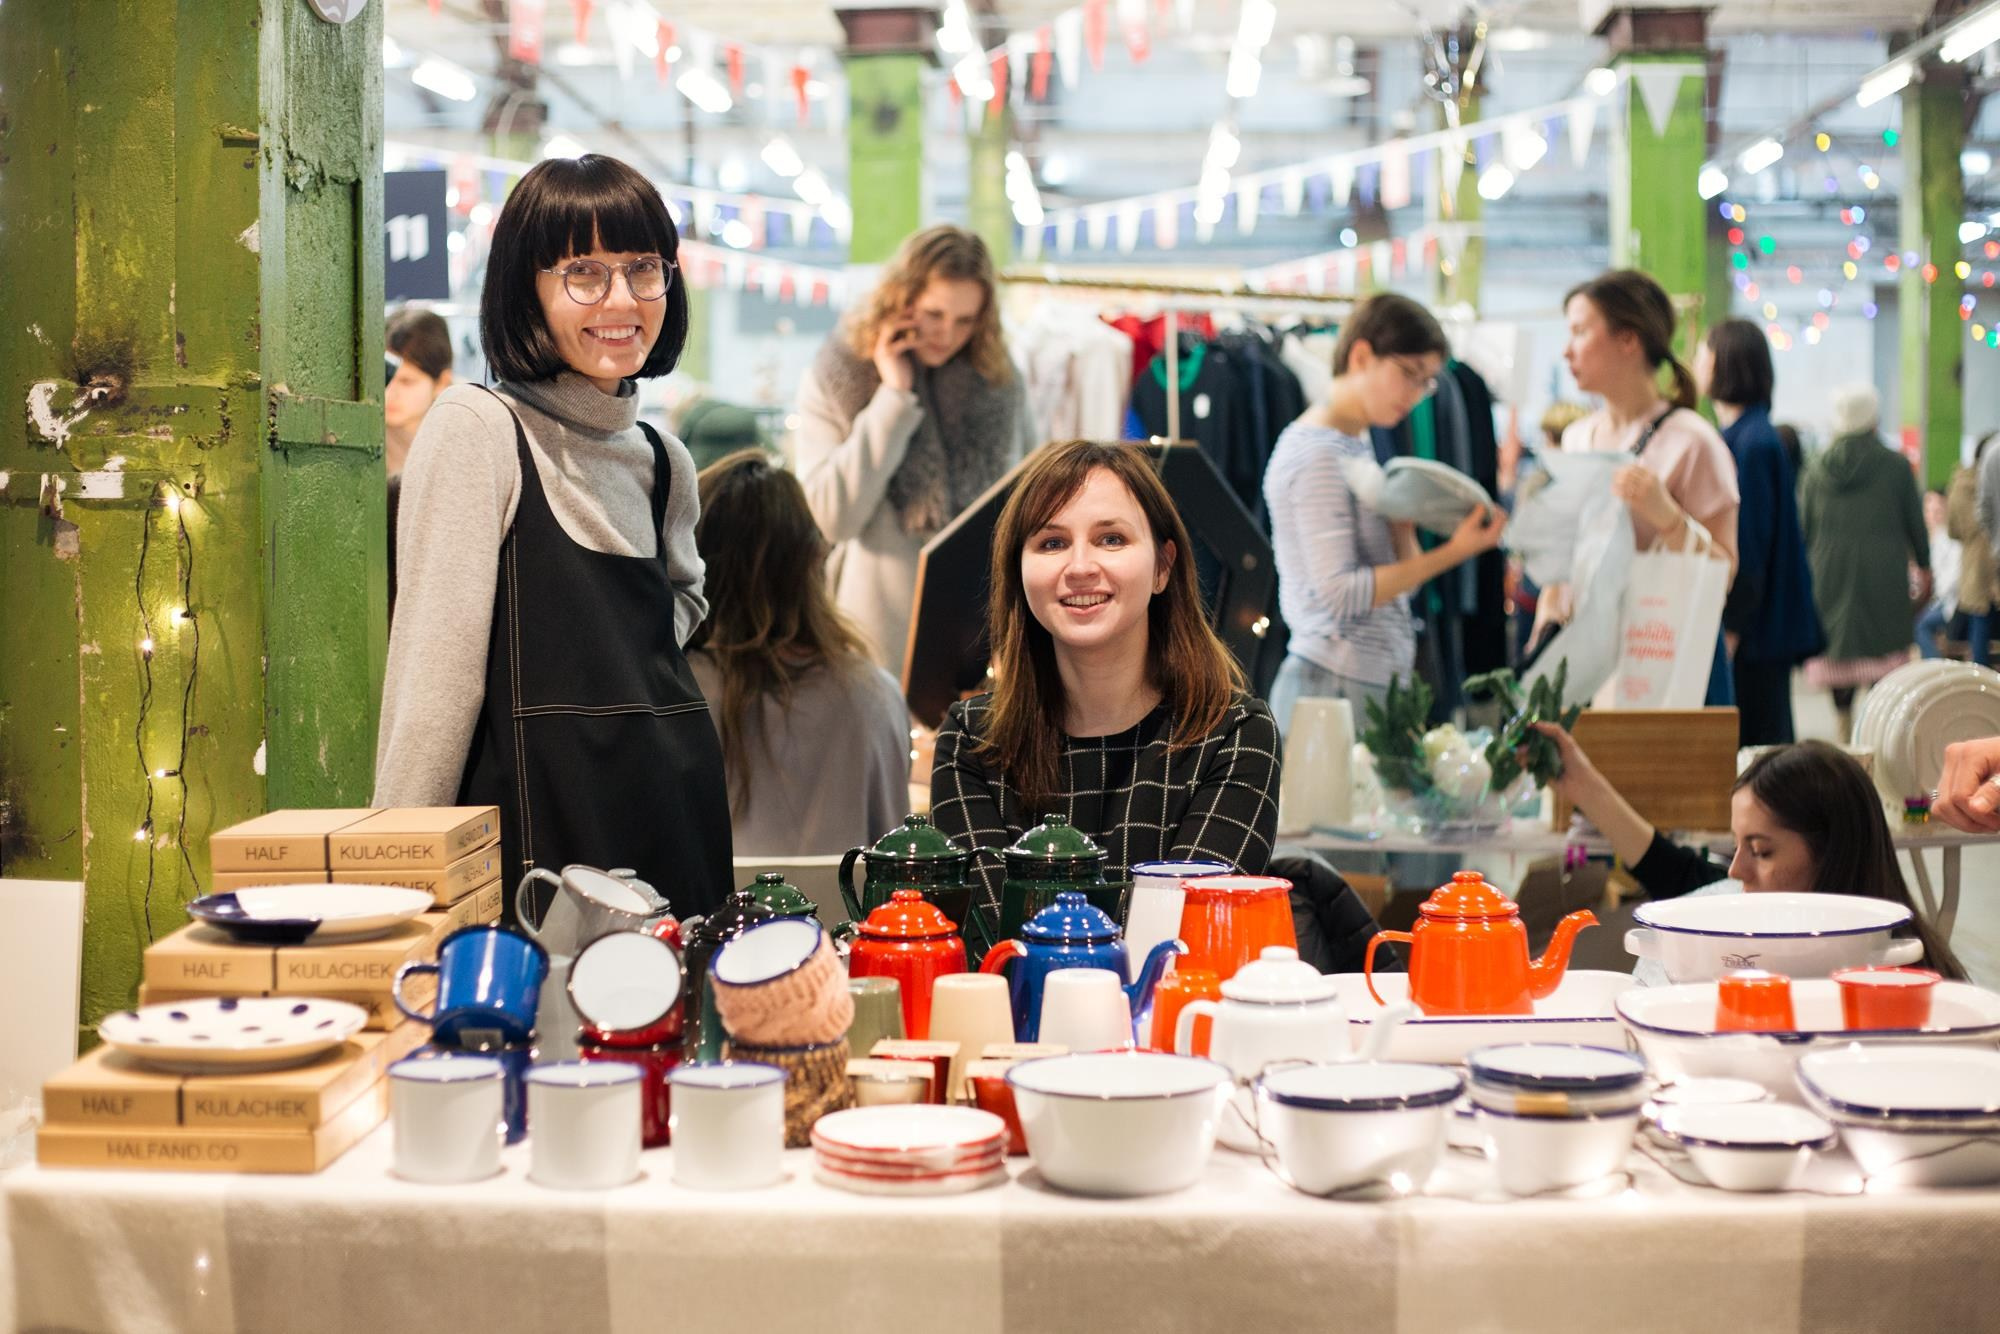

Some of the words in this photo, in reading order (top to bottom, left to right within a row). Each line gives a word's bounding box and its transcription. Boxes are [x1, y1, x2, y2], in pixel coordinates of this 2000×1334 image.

[245, 846, 289, 861] HALF
[339, 844, 435, 860] KULACHEK
[182, 962, 232, 979] HALF
[288, 962, 394, 979] KULACHEK
[80, 1096, 134, 1115] HALF
[195, 1098, 308, 1118] KULACHEK
